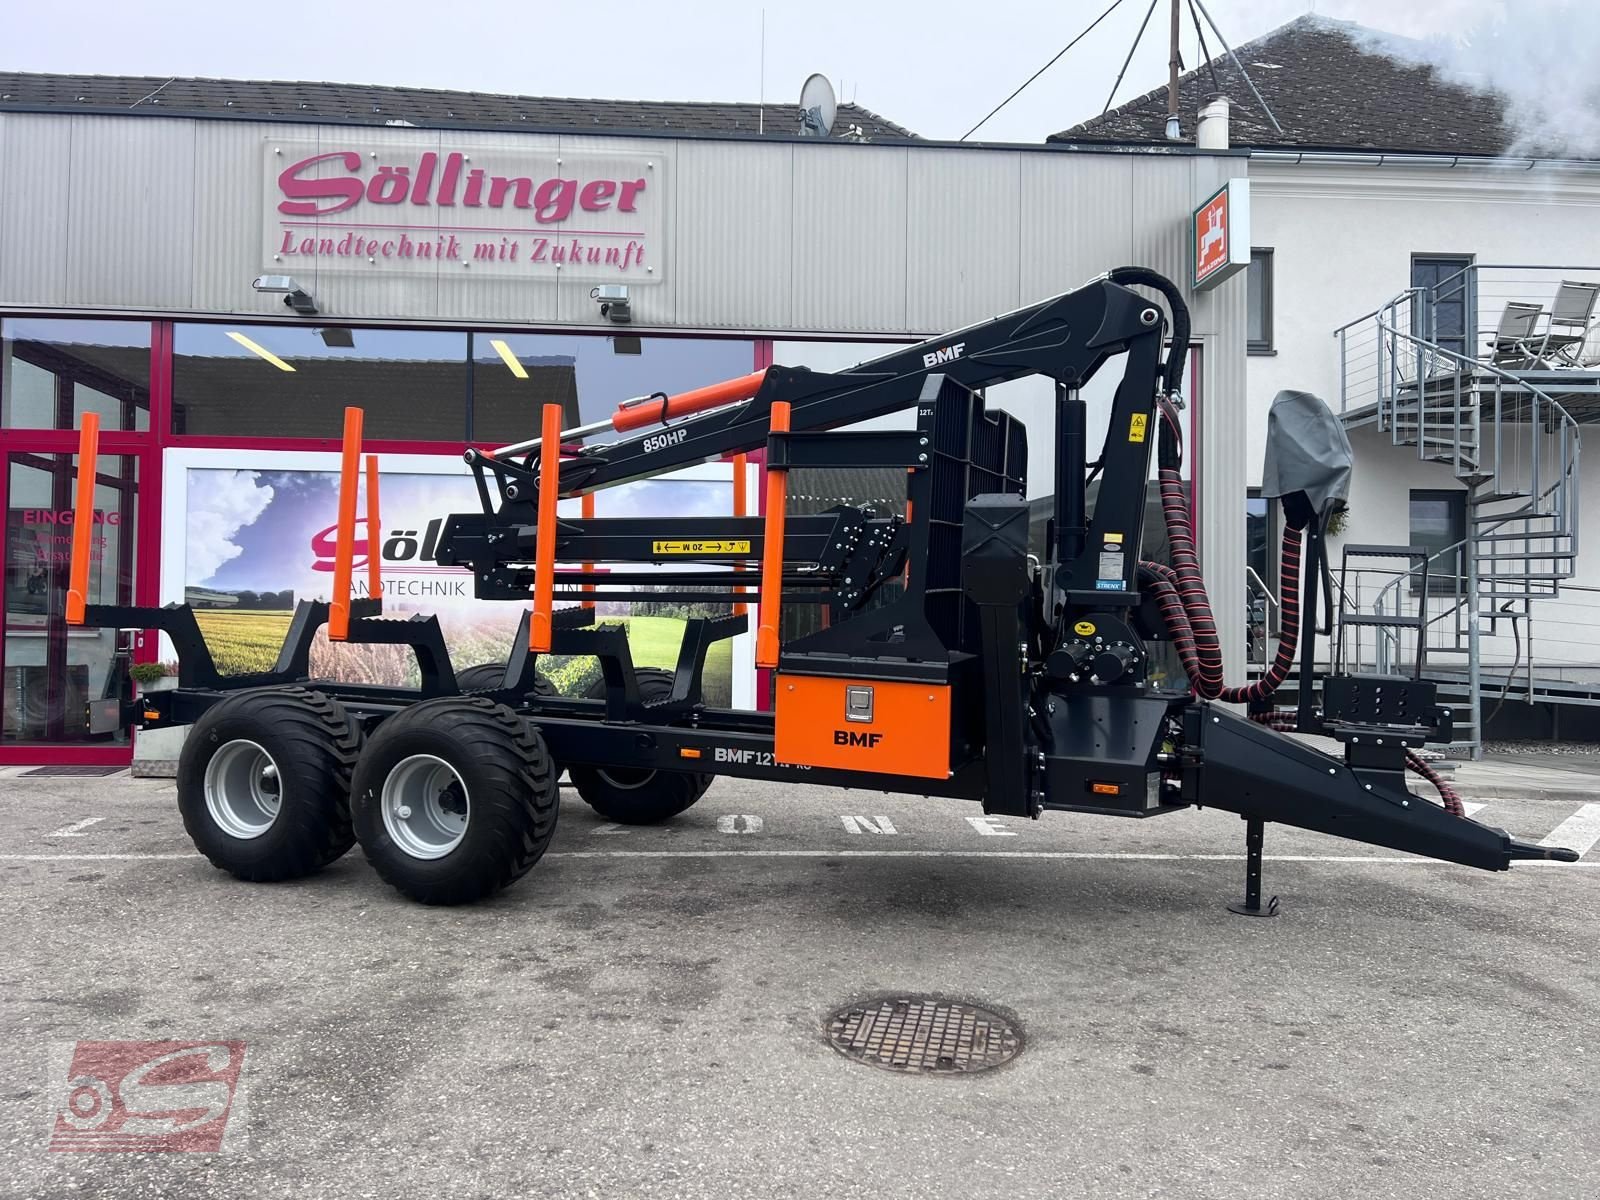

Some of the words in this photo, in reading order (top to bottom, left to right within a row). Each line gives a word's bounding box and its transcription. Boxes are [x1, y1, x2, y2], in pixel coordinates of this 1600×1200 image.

[277, 151, 646, 224] Söllinger
[279, 230, 462, 260] Landtechnik
[473, 236, 520, 262] mit
[530, 237, 646, 270] Zukunft
[923, 342, 966, 368] BMF
[643, 429, 687, 453] 850HP
[23, 509, 121, 525] EINGNG
[311, 518, 443, 572] Söl
[693, 543, 703, 551] 20
[834, 730, 883, 748] BMF
[714, 748, 755, 764] BMF
